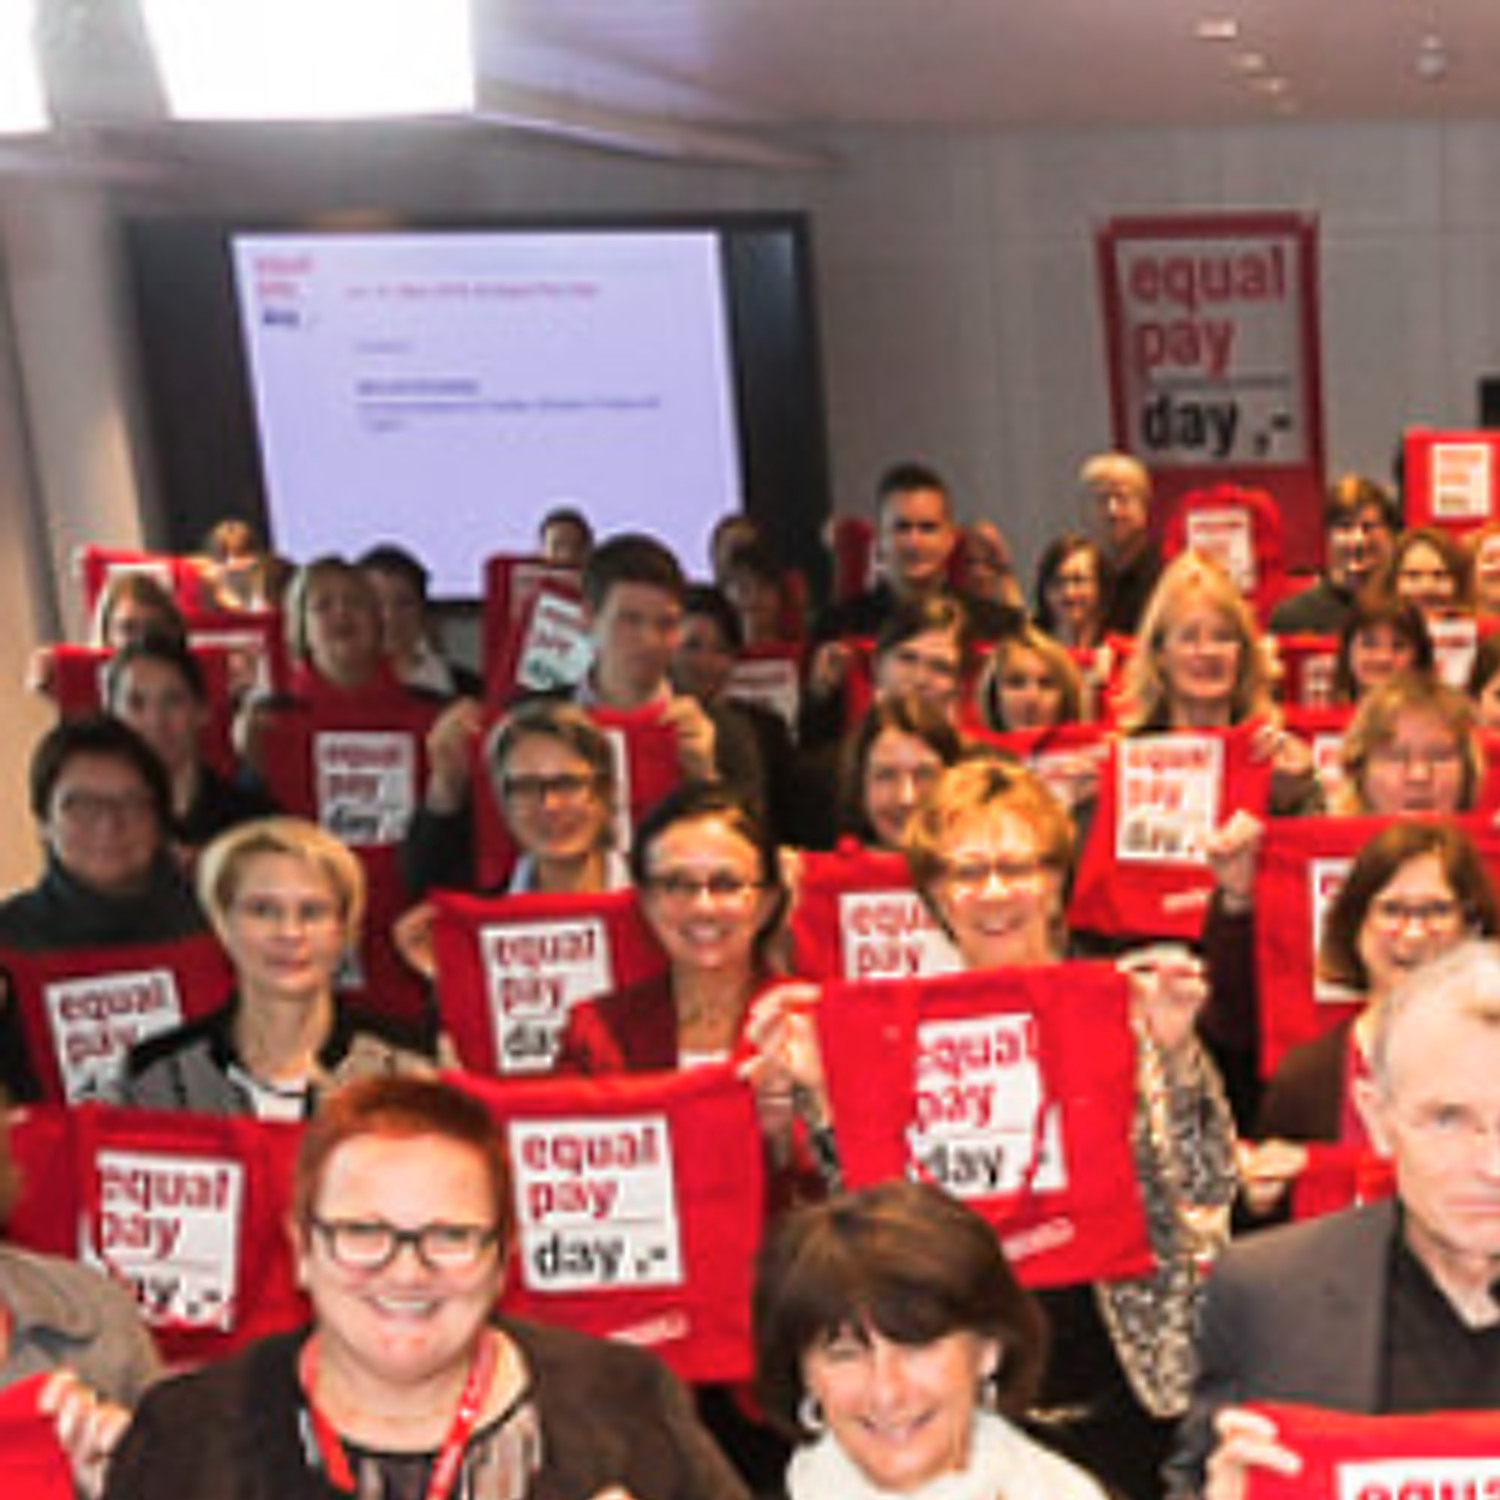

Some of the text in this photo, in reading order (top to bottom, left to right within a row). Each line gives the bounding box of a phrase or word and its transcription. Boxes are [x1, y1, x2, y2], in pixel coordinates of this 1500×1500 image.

[1129, 246, 1287, 314] equal
[1133, 318, 1234, 383] pay
[521, 1126, 658, 1175] equal
[526, 1178, 618, 1221] pay
